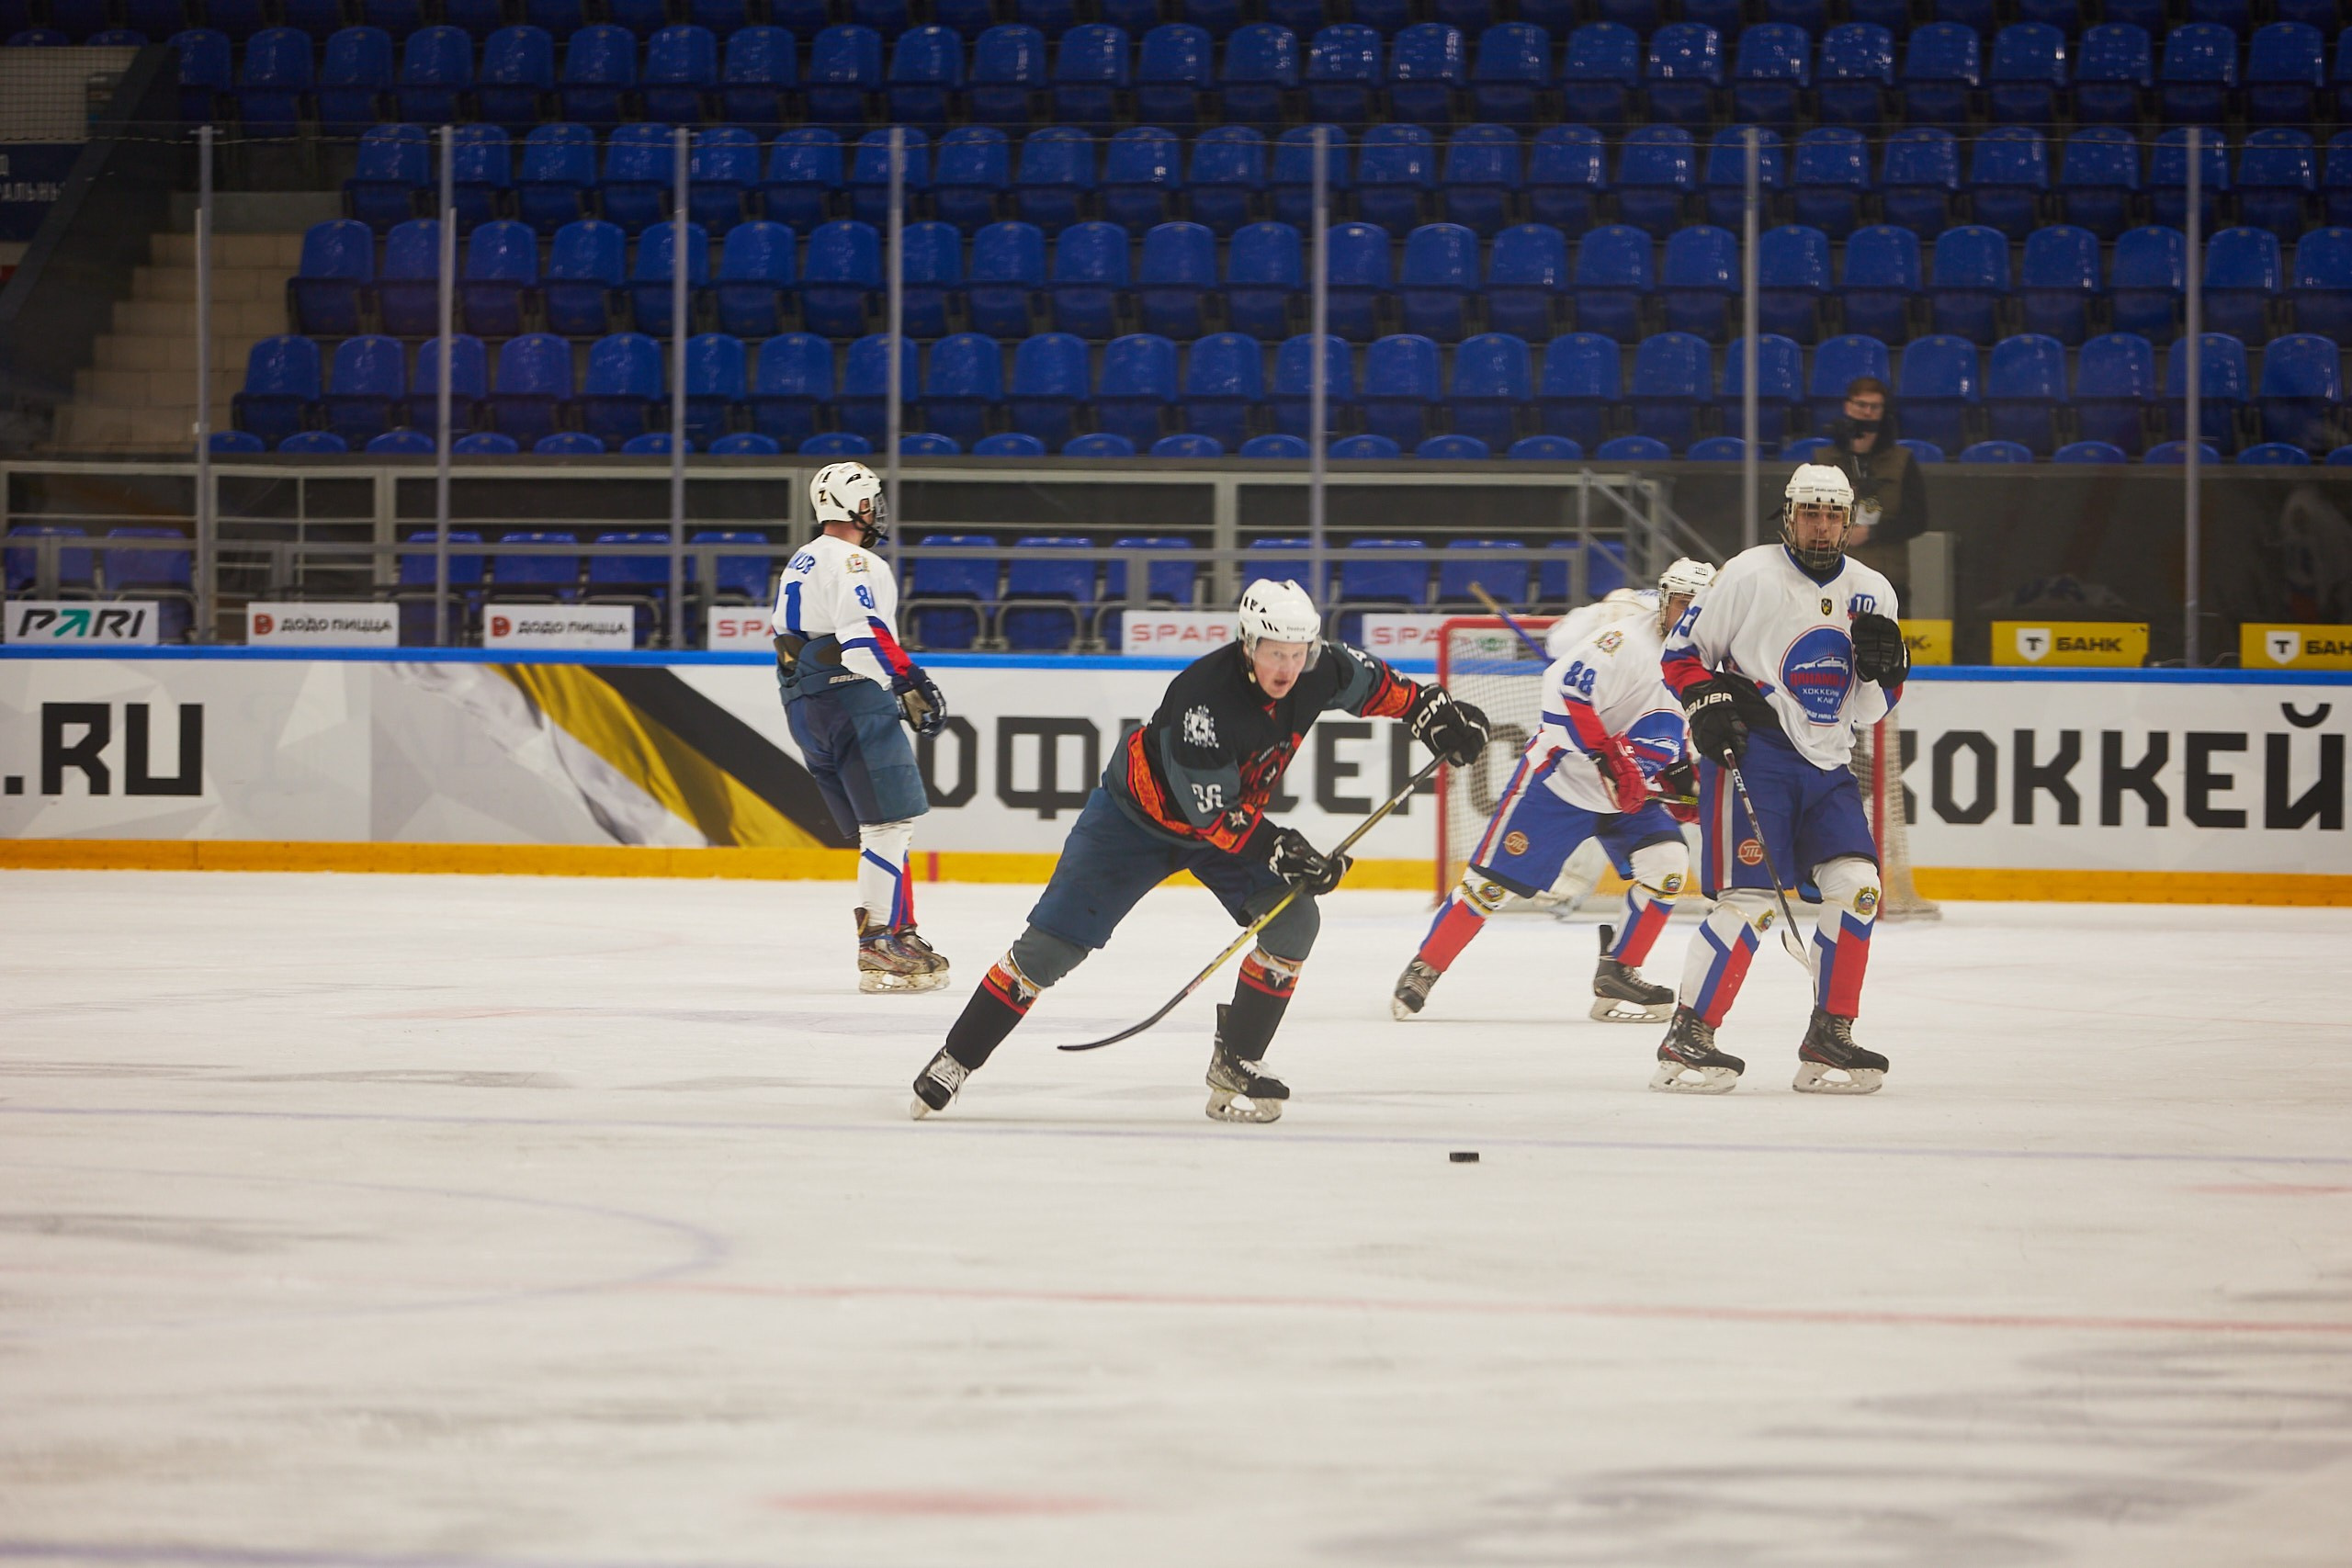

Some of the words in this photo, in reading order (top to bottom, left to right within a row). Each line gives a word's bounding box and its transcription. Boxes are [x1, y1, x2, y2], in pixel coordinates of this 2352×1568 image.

[17, 608, 145, 637] PARI
[279, 618, 329, 633] ДОДО
[331, 619, 391, 634] ПИЦЦА
[1130, 624, 1228, 642] SPAR
[2056, 637, 2122, 651] БАНК
[2306, 640, 2352, 656] БАН
[1564, 660, 1596, 696] 88
[1410, 691, 1448, 739] CCM
